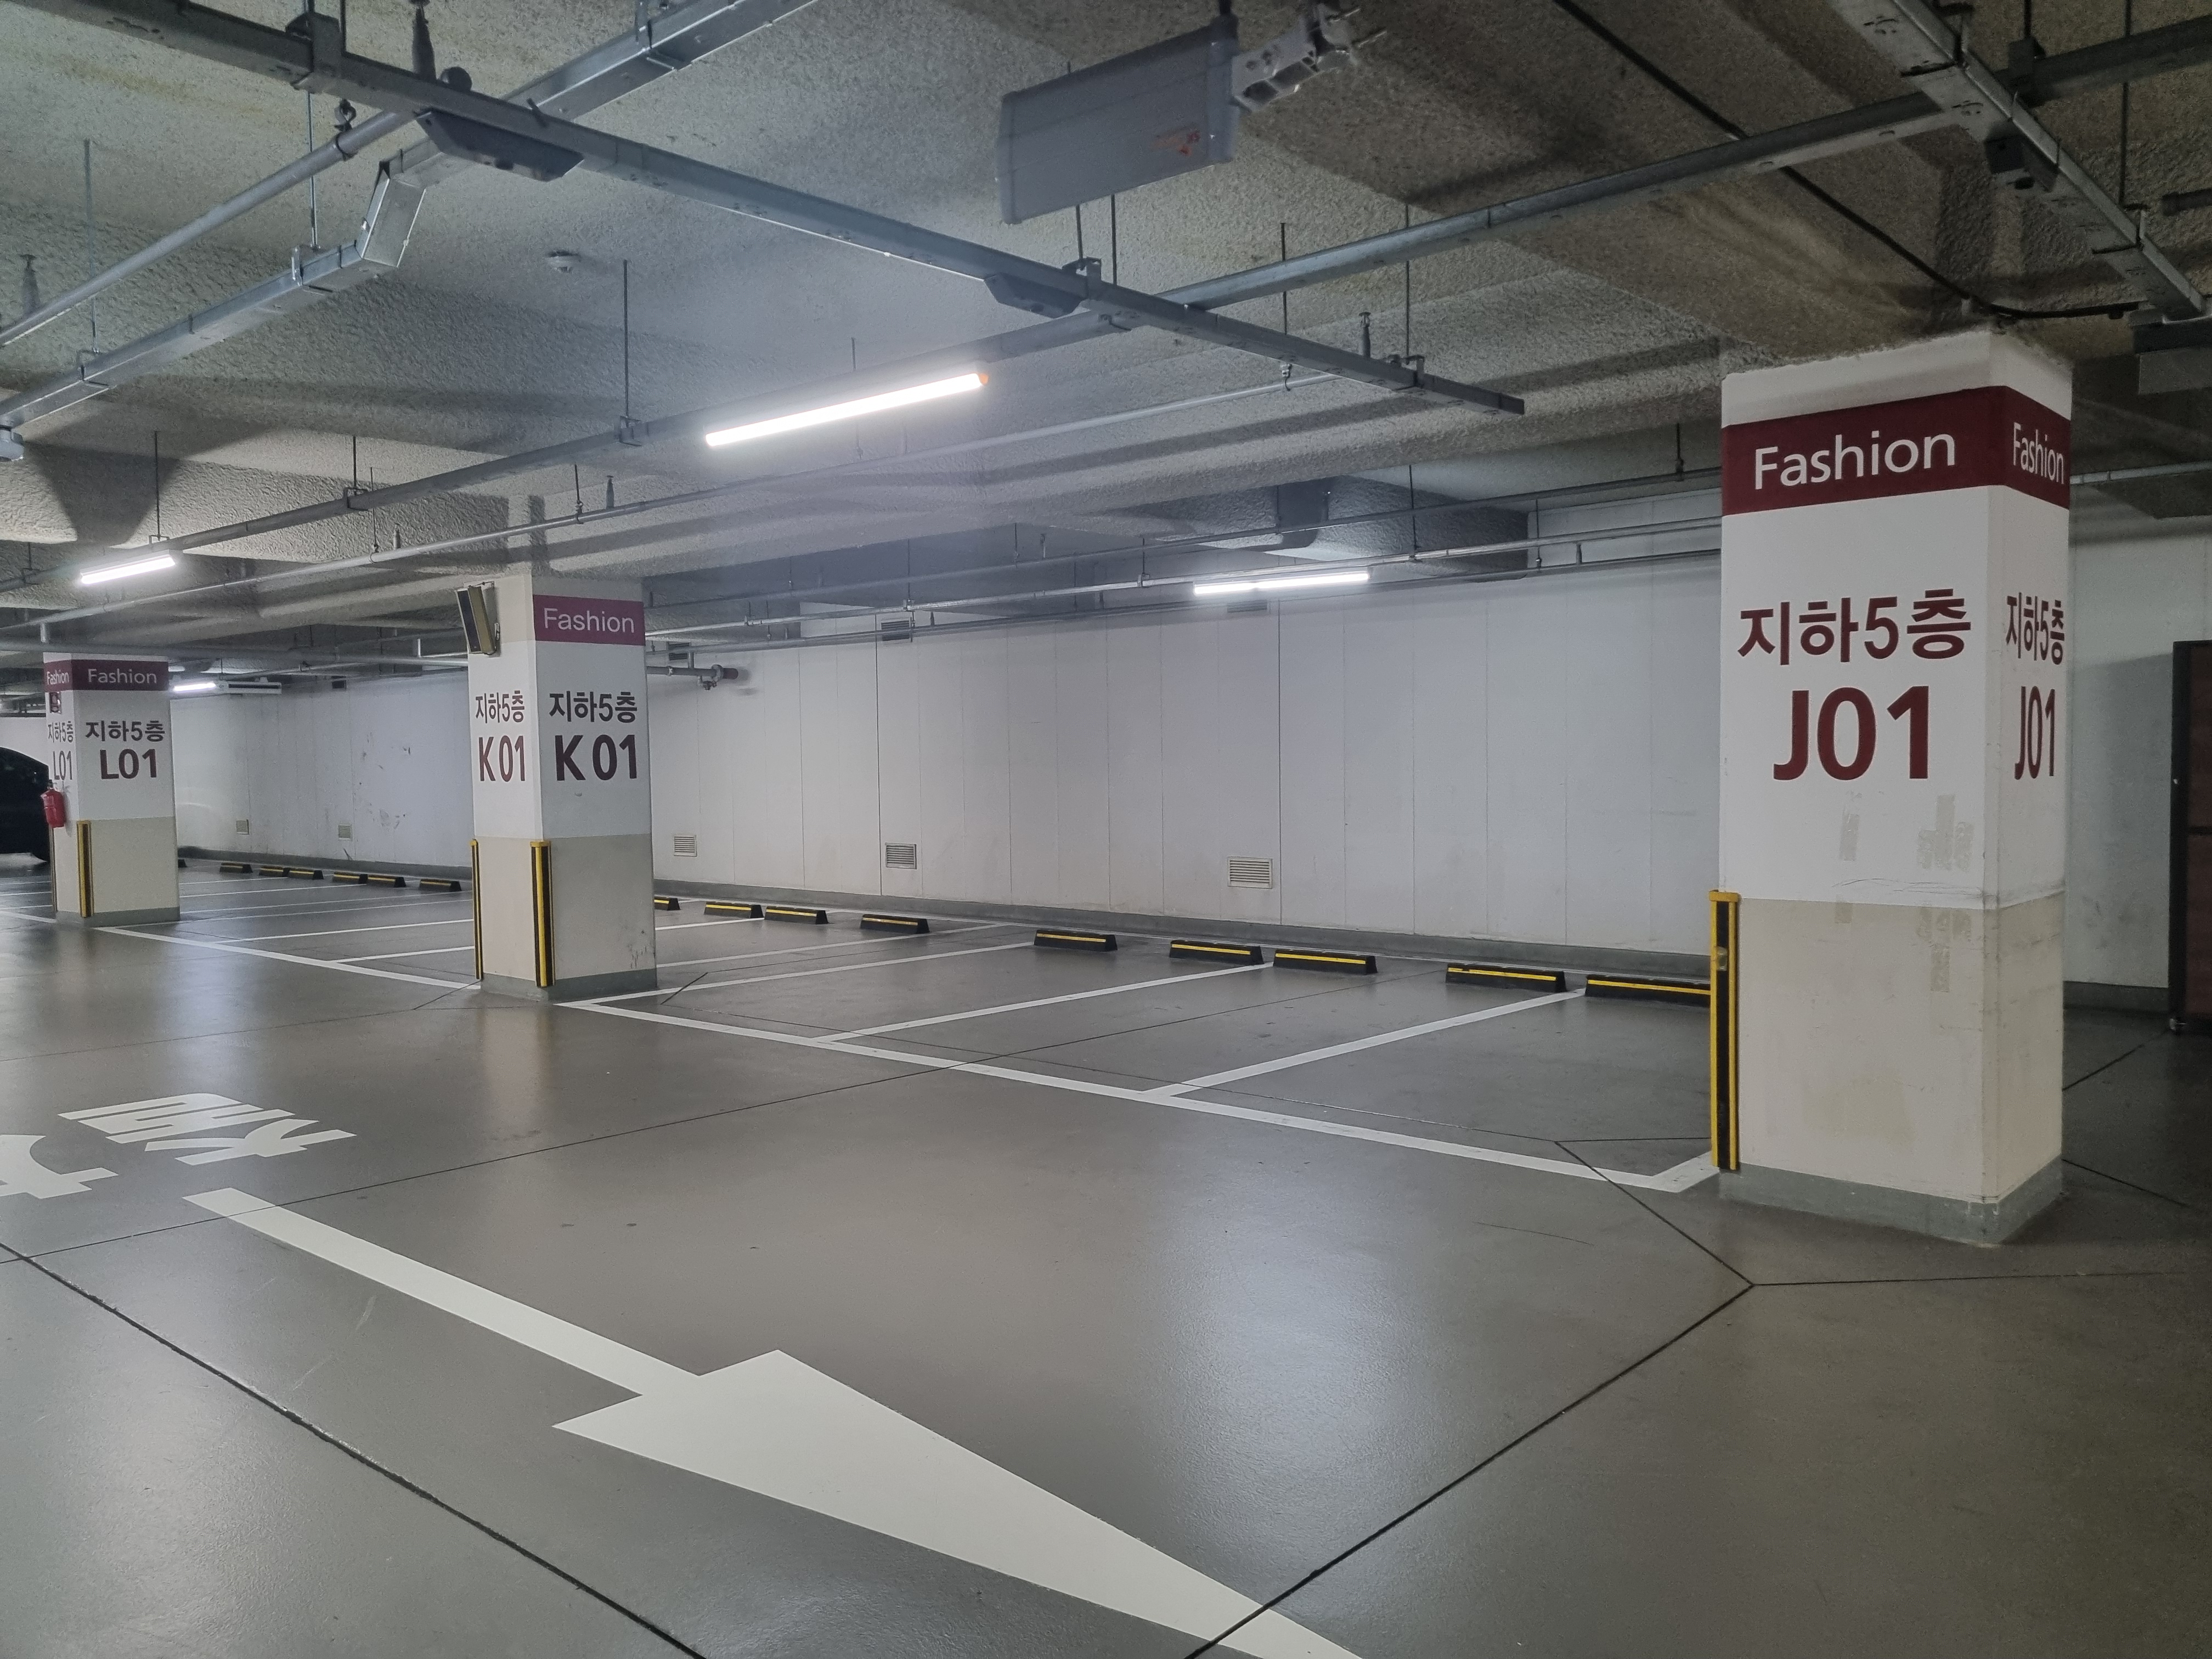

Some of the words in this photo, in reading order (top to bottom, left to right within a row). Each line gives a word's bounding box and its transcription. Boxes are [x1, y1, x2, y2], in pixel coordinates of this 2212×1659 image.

[1755, 430, 1956, 490] Fashion
[2013, 422, 2064, 485] Fashion
[543, 607, 635, 633] Fashion
[1737, 588, 1972, 666] 지하5층
[2006, 592, 2066, 665] 지하5층
[47, 670, 69, 685] Fashion
[88, 668, 157, 684] Fashion
[475, 690, 525, 724] 지하5층
[549, 691, 637, 723] 지하5층
[48, 720, 74, 743] 지하5층
[85, 720, 166, 742] 지하5층
[1773, 686, 1929, 781] J01
[2015, 686, 2056, 780] J01
[52, 750, 73, 781] L01
[100, 748, 157, 780] L01
[478, 735, 526, 782] K01
[555, 735, 637, 781] K01
